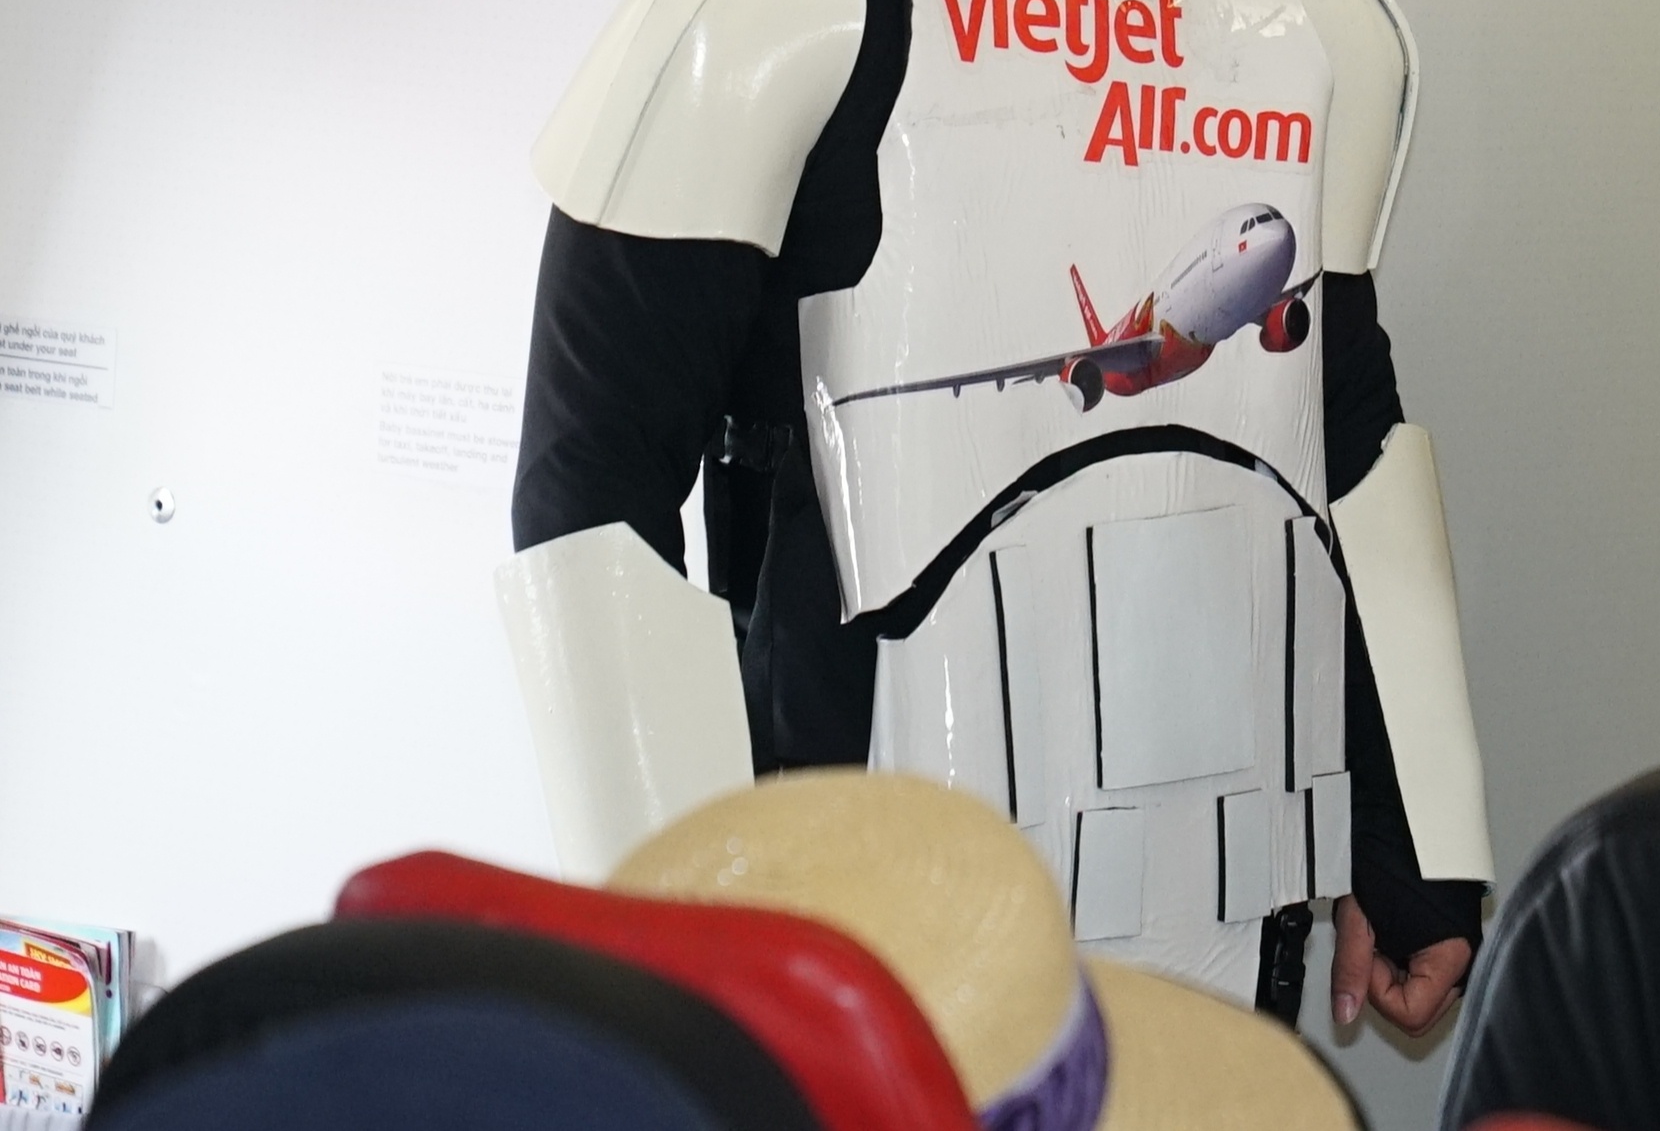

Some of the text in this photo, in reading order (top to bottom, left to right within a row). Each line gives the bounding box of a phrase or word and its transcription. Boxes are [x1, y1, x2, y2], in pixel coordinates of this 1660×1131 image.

[1084, 81, 1312, 166] Air.com
[8, 340, 33, 352] under
[36, 345, 56, 355] your
[59, 348, 77, 358] seat
[4, 382, 22, 393] seat
[25, 384, 41, 396] belt
[44, 387, 67, 399] while
[69, 392, 98, 403] seated
[473, 433, 484, 443] be
